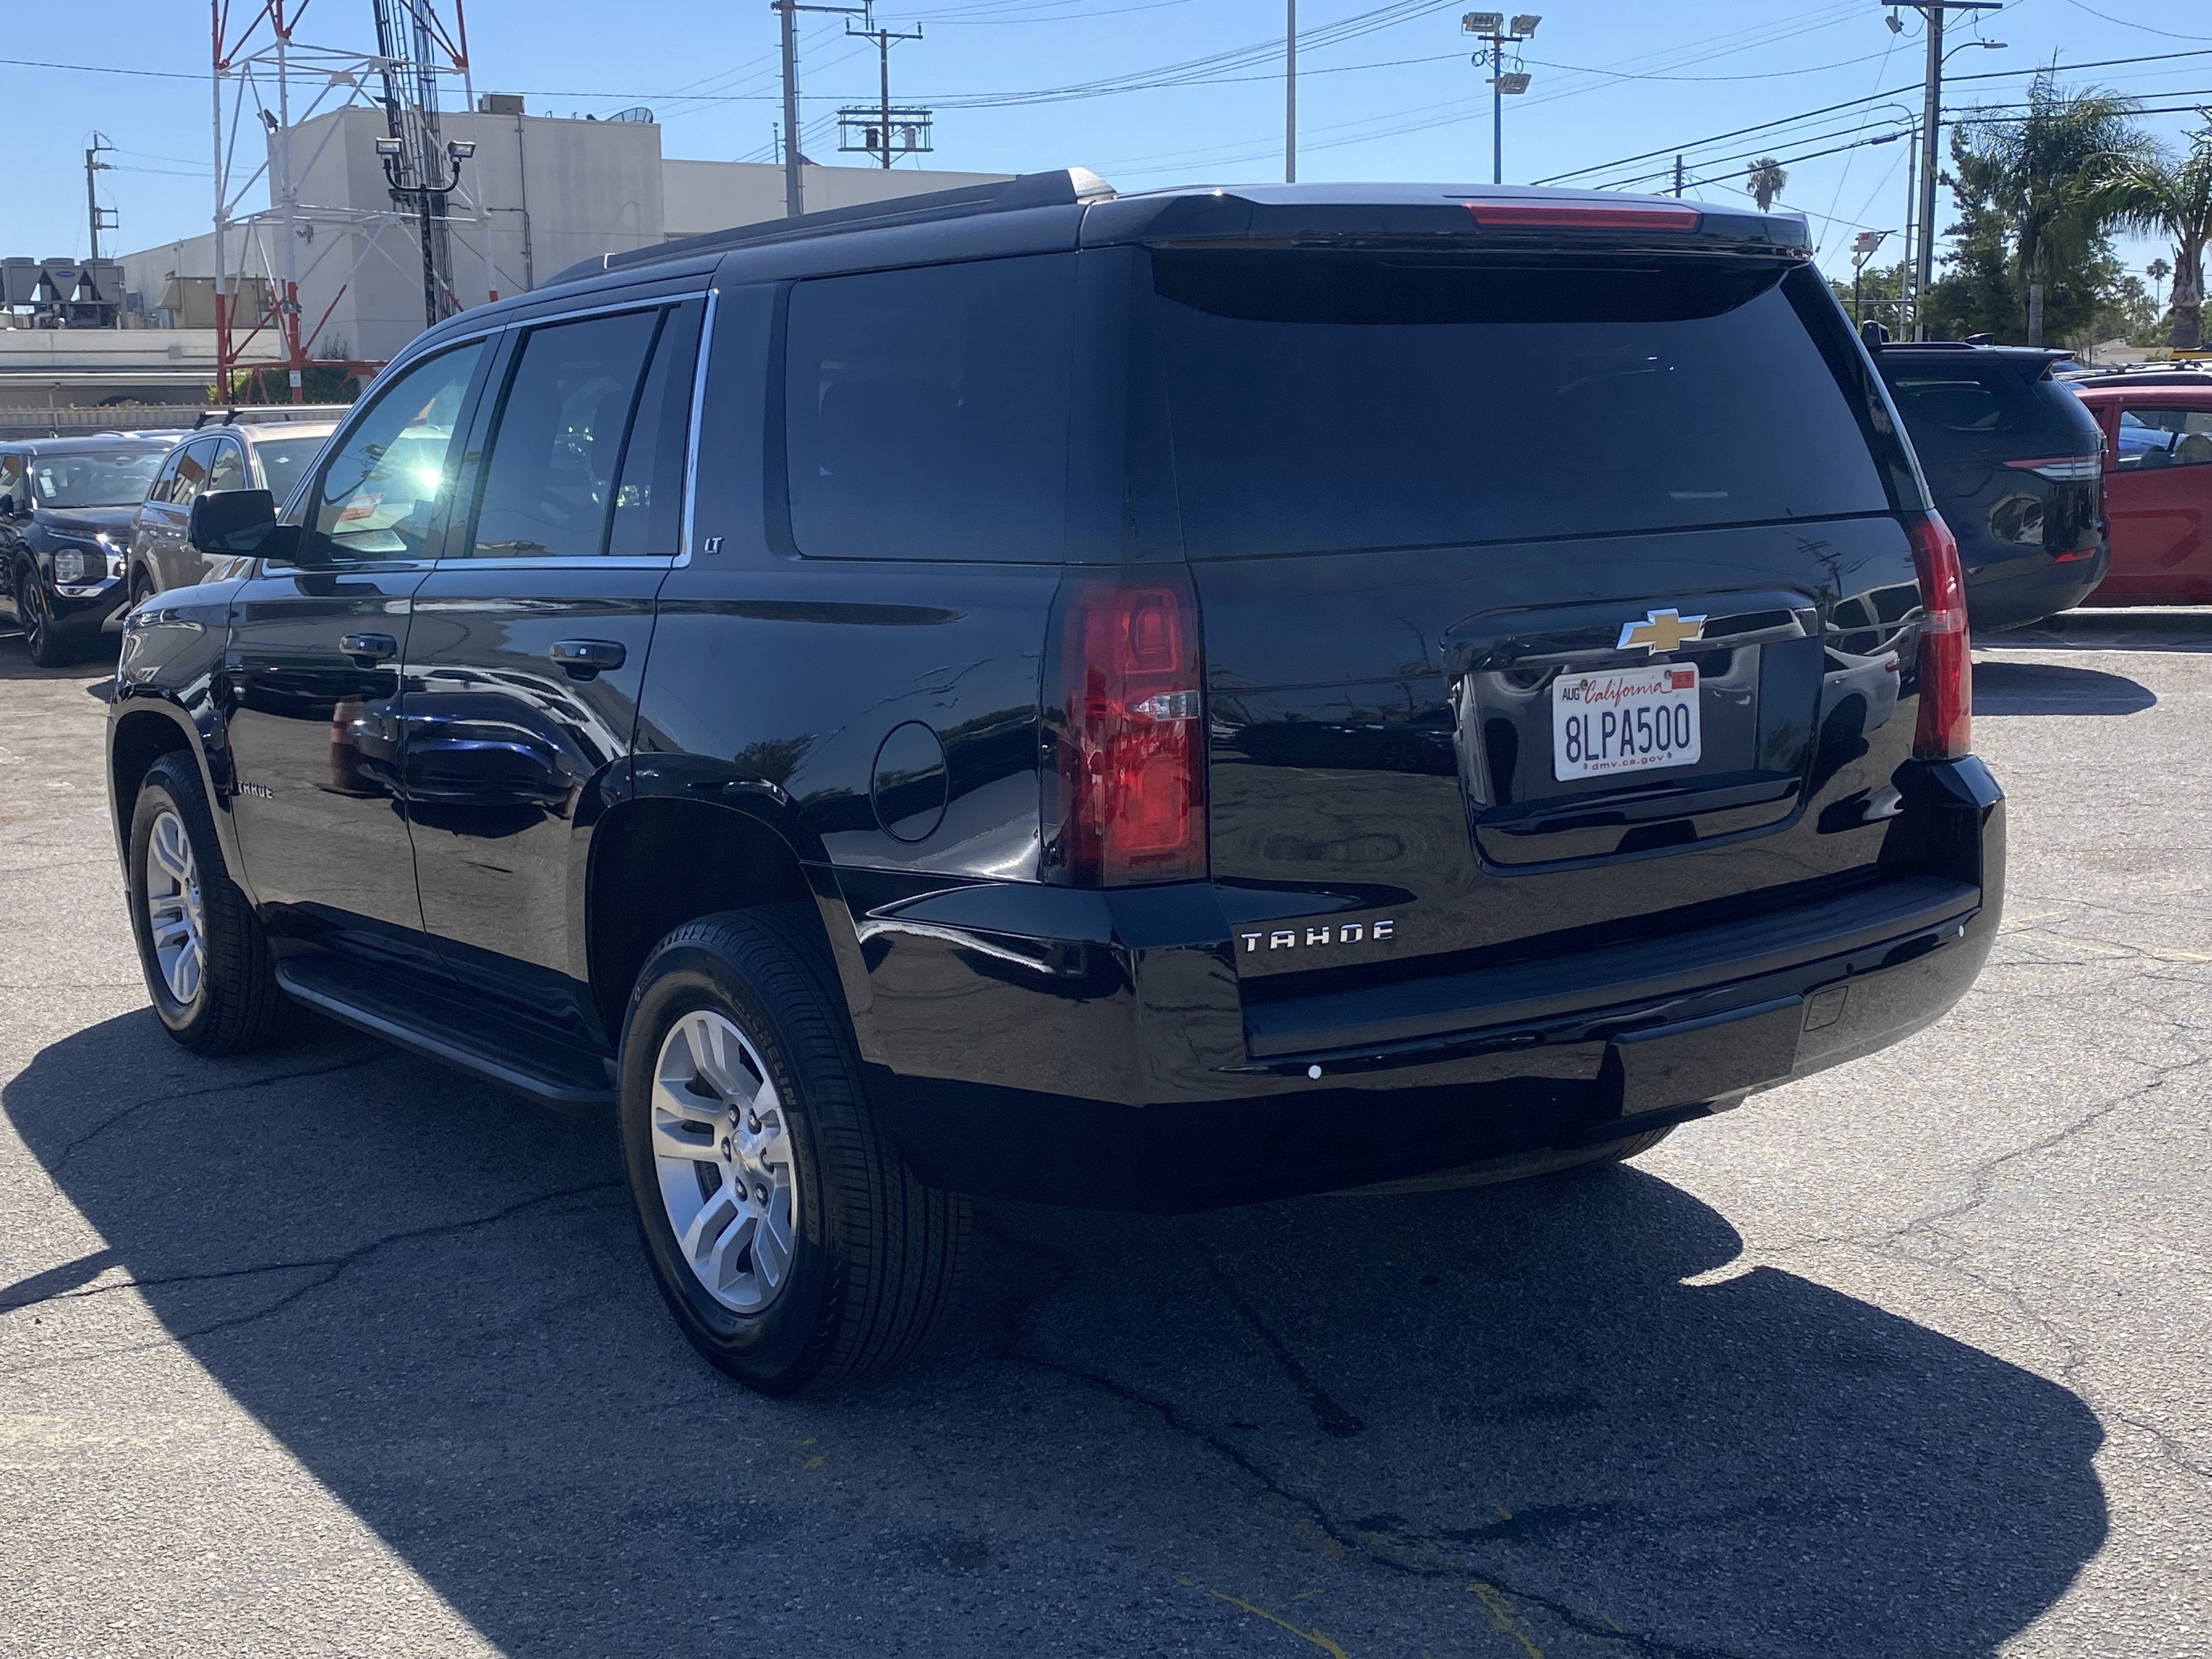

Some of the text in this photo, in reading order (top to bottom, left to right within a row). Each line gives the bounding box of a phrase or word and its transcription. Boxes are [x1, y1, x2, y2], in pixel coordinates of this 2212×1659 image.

[704, 537, 723, 554] LT
[1562, 687, 1580, 701] AUG
[1584, 677, 1673, 708] California
[1566, 703, 1690, 763] 8LPA500
[1592, 754, 1664, 770] dmv.ca.gov
[238, 780, 273, 799] TAHOE
[1240, 920, 1394, 952] TAHOE
